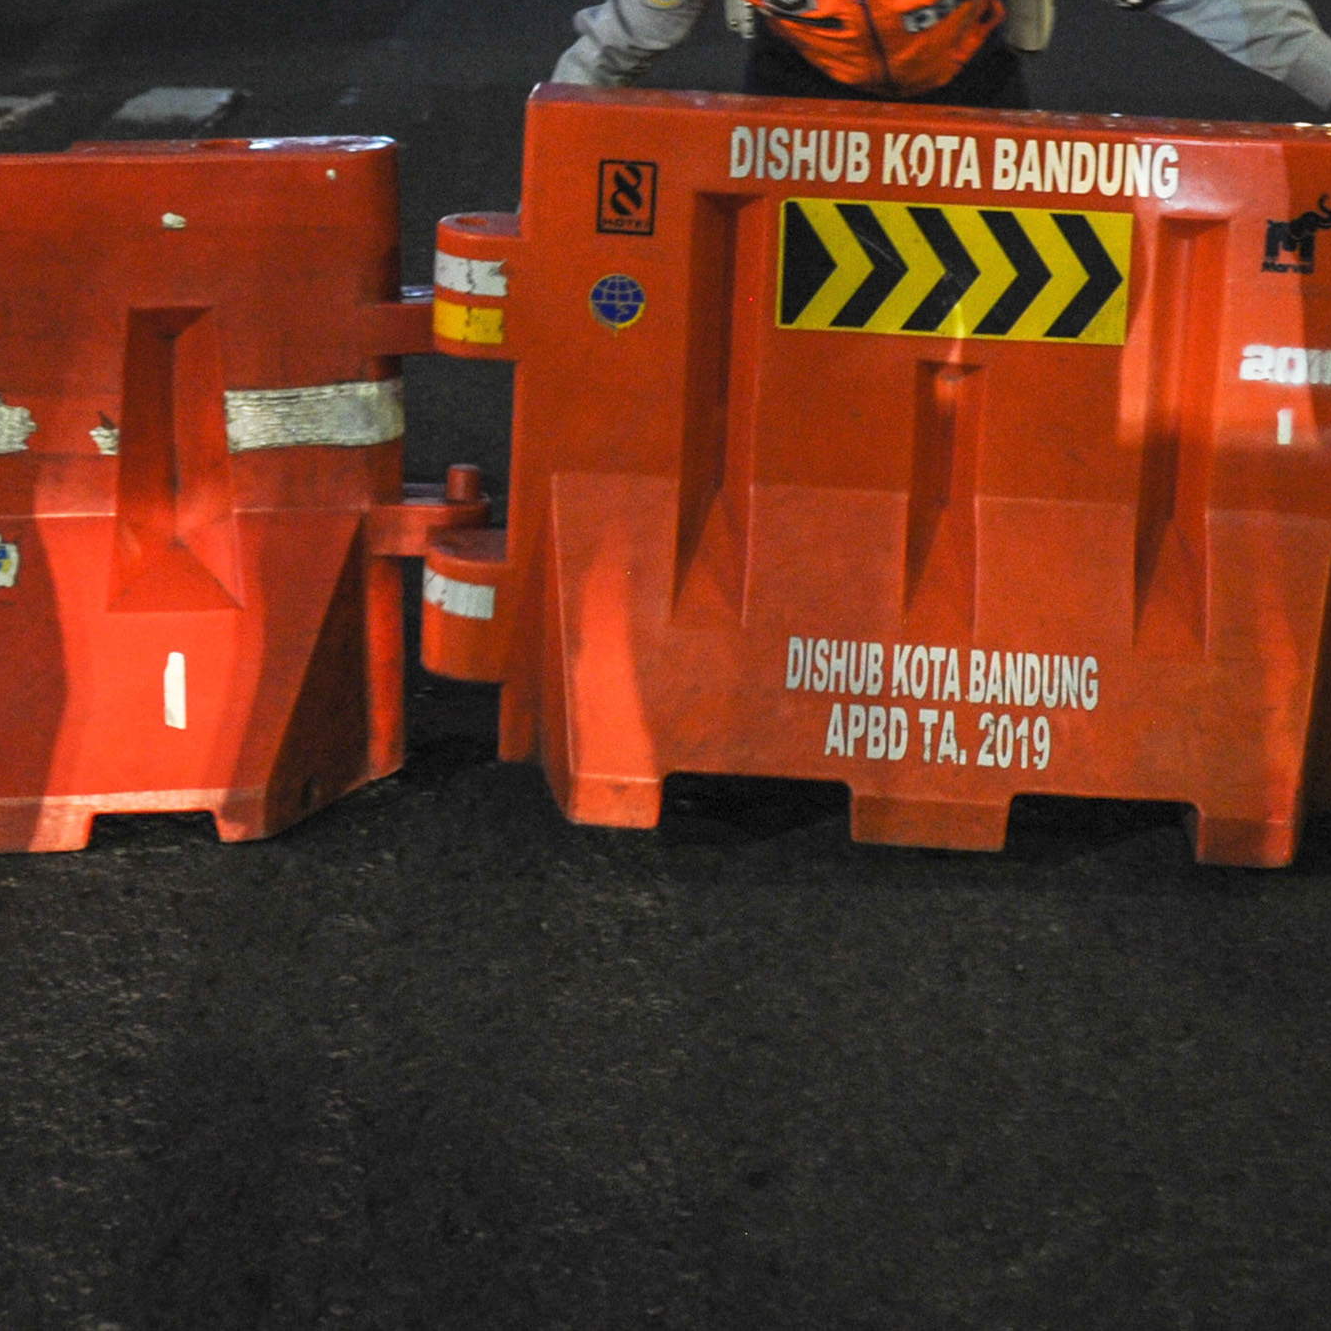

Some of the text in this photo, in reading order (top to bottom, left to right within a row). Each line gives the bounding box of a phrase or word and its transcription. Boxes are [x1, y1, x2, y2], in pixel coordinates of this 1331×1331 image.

[729, 126, 1180, 199] DISHUB KOTA BANDUNG
[786, 637, 1099, 711] DISHUB KOTA BANDUNG
[824, 703, 1051, 770] APBD TA. 2019
